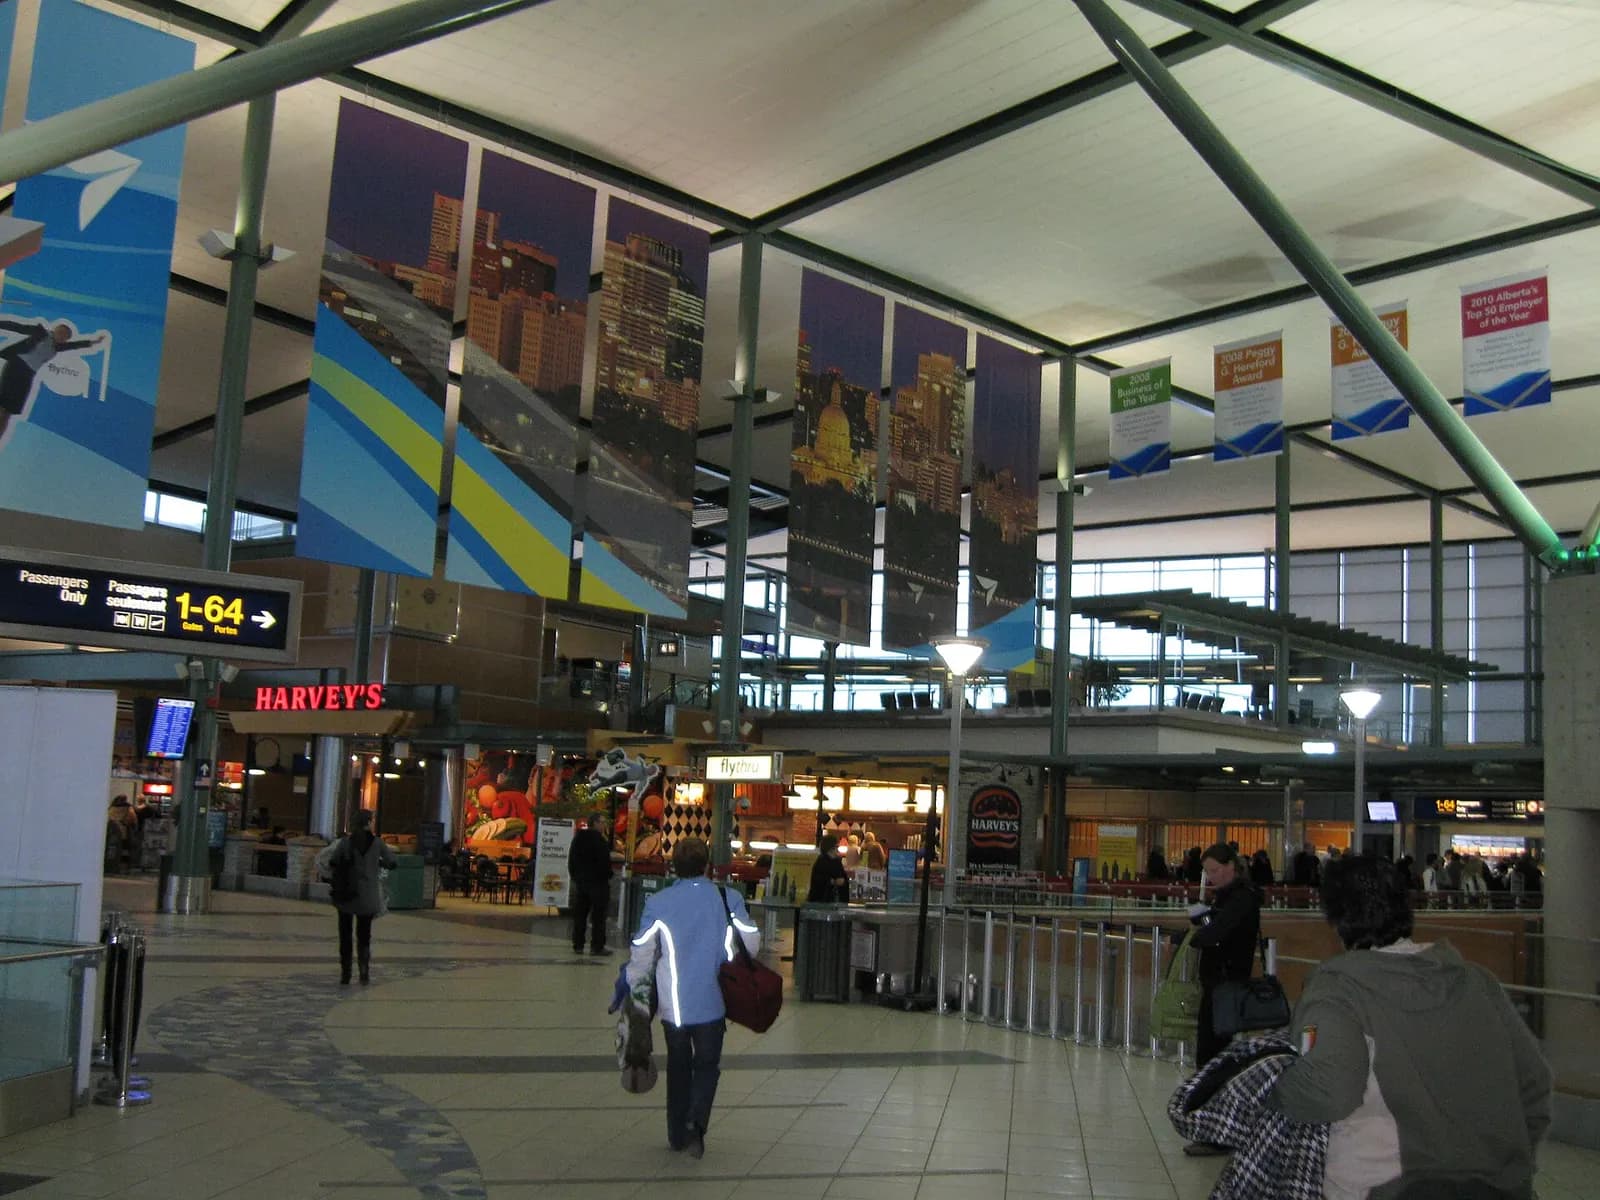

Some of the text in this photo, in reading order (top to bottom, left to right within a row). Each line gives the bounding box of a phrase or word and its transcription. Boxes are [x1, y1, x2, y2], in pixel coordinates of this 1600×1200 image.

[1470, 284, 1539, 307] 2010 Alberta's
[1465, 311, 1482, 321] Top
[1499, 296, 1544, 313] Employer
[1479, 311, 1531, 328] of the Year
[1246, 345, 1275, 360] Peggy
[1232, 355, 1276, 373] Hereford
[1232, 370, 1264, 385] Award
[1117, 378, 1164, 399] Business of
[1122, 393, 1158, 409] the Year
[20, 569, 89, 589] Passengers
[60, 589, 88, 606] Only
[106, 596, 167, 612] seulement
[176, 592, 244, 625] 1-64
[255, 682, 383, 711] HARVEY'S
[720, 757, 760, 777] flythru
[971, 818, 1019, 832] HARVEY'S
